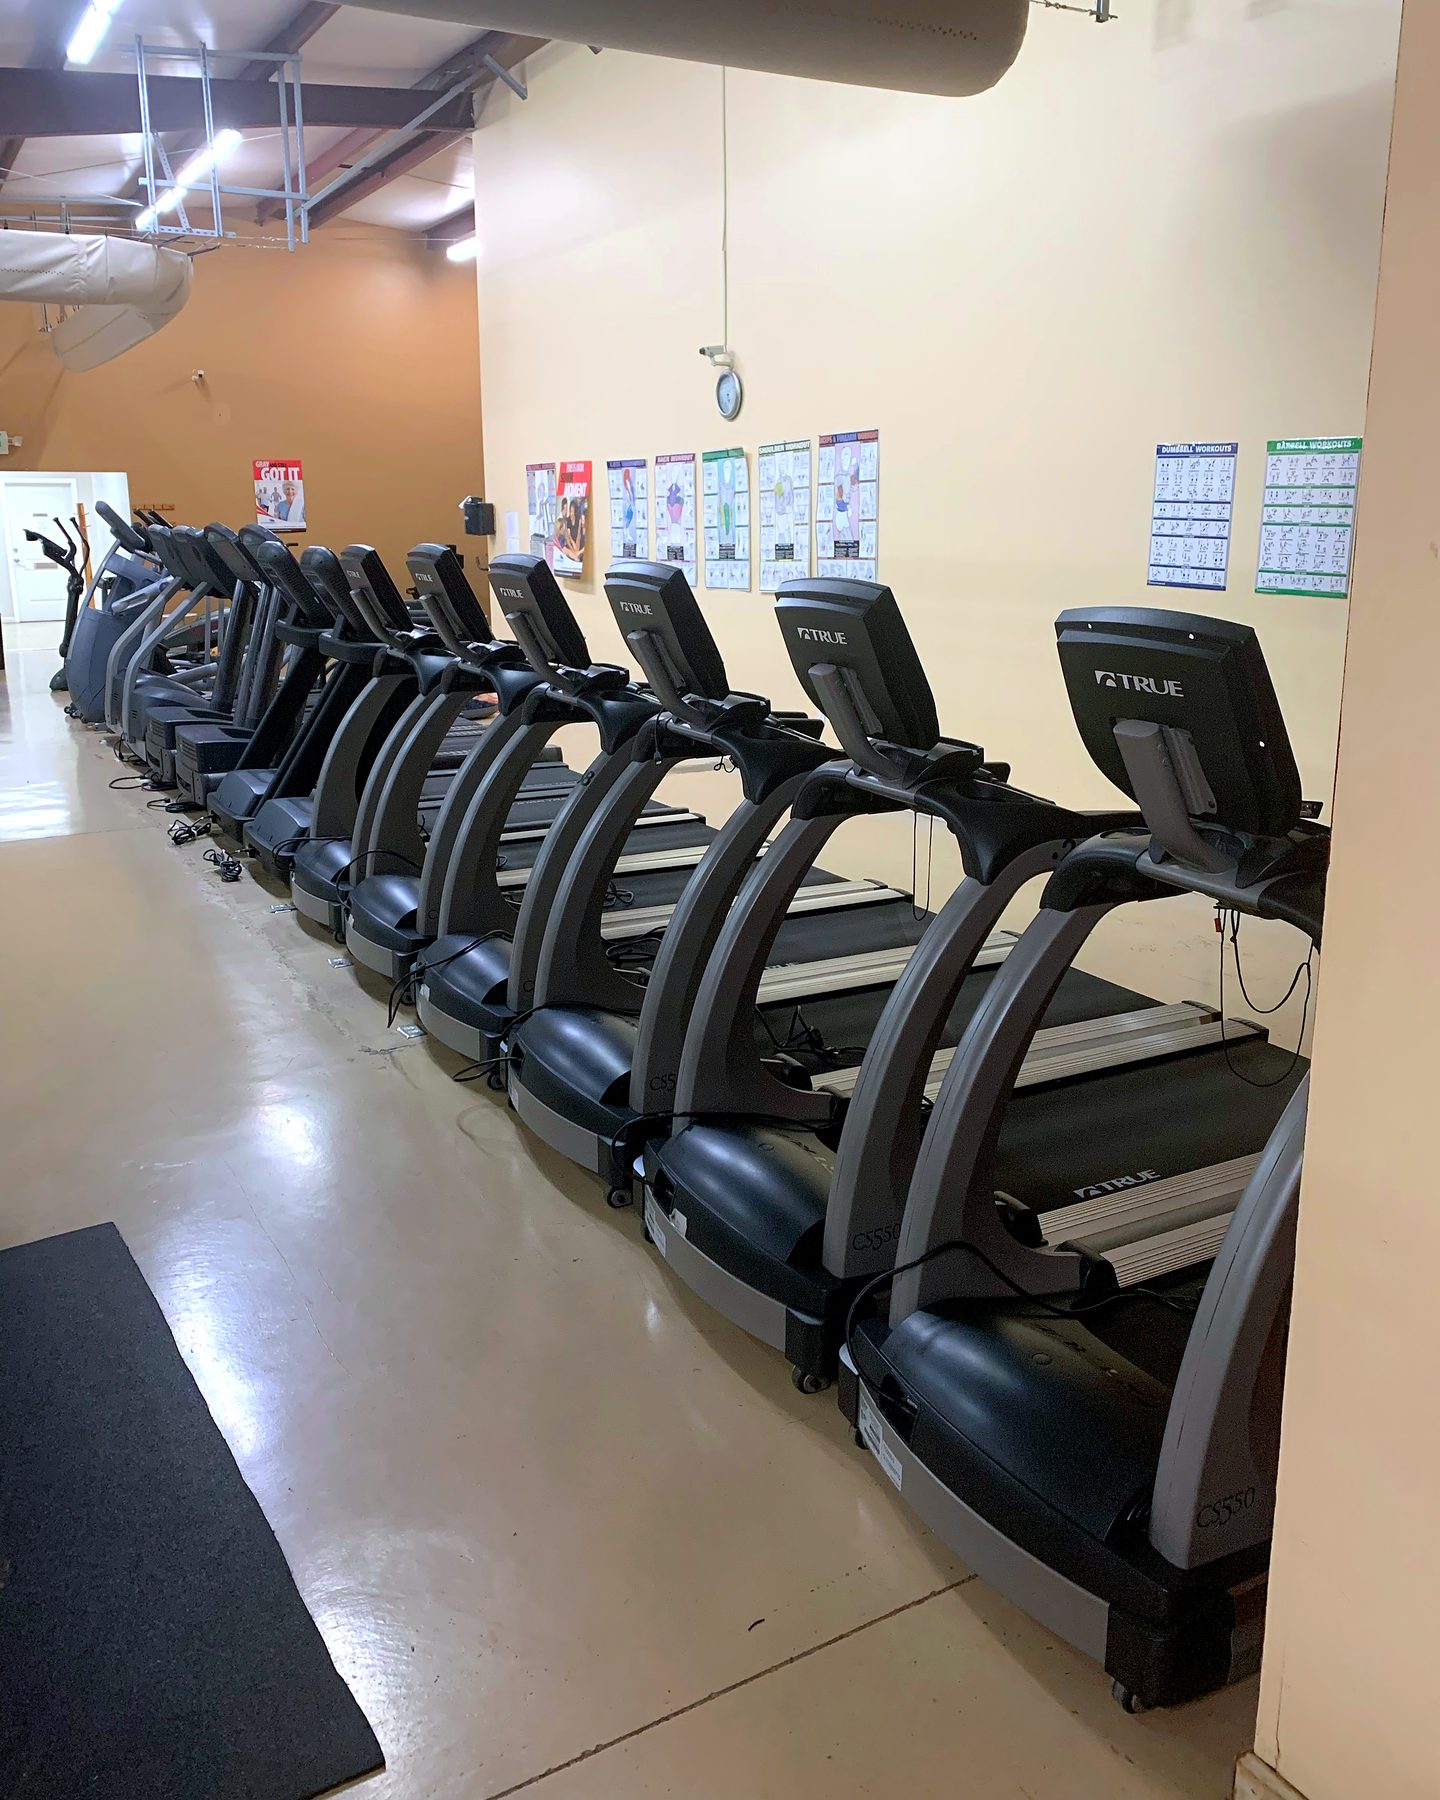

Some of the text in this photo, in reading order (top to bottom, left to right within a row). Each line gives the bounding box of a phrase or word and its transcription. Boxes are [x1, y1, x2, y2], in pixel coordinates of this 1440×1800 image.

[759, 440, 810, 454] SHOULDER WORKOUT
[1195, 444, 1232, 453] WORKOUTS
[1310, 440, 1352, 449] WORKOUTS
[670, 454, 693, 462] WORKOUT
[261, 467, 300, 481] GOT IT
[563, 482, 588, 497] MOMENT
[505, 589, 524, 599] TRUE
[628, 602, 653, 615] TRUE
[809, 629, 848, 645] TRUE
[1116, 673, 1184, 697] TRUE
[650, 1073, 677, 1091] CS5
[1096, 1169, 1160, 1191] TRUE
[852, 1223, 901, 1251] CS550
[1197, 1486, 1255, 1528] CS550
